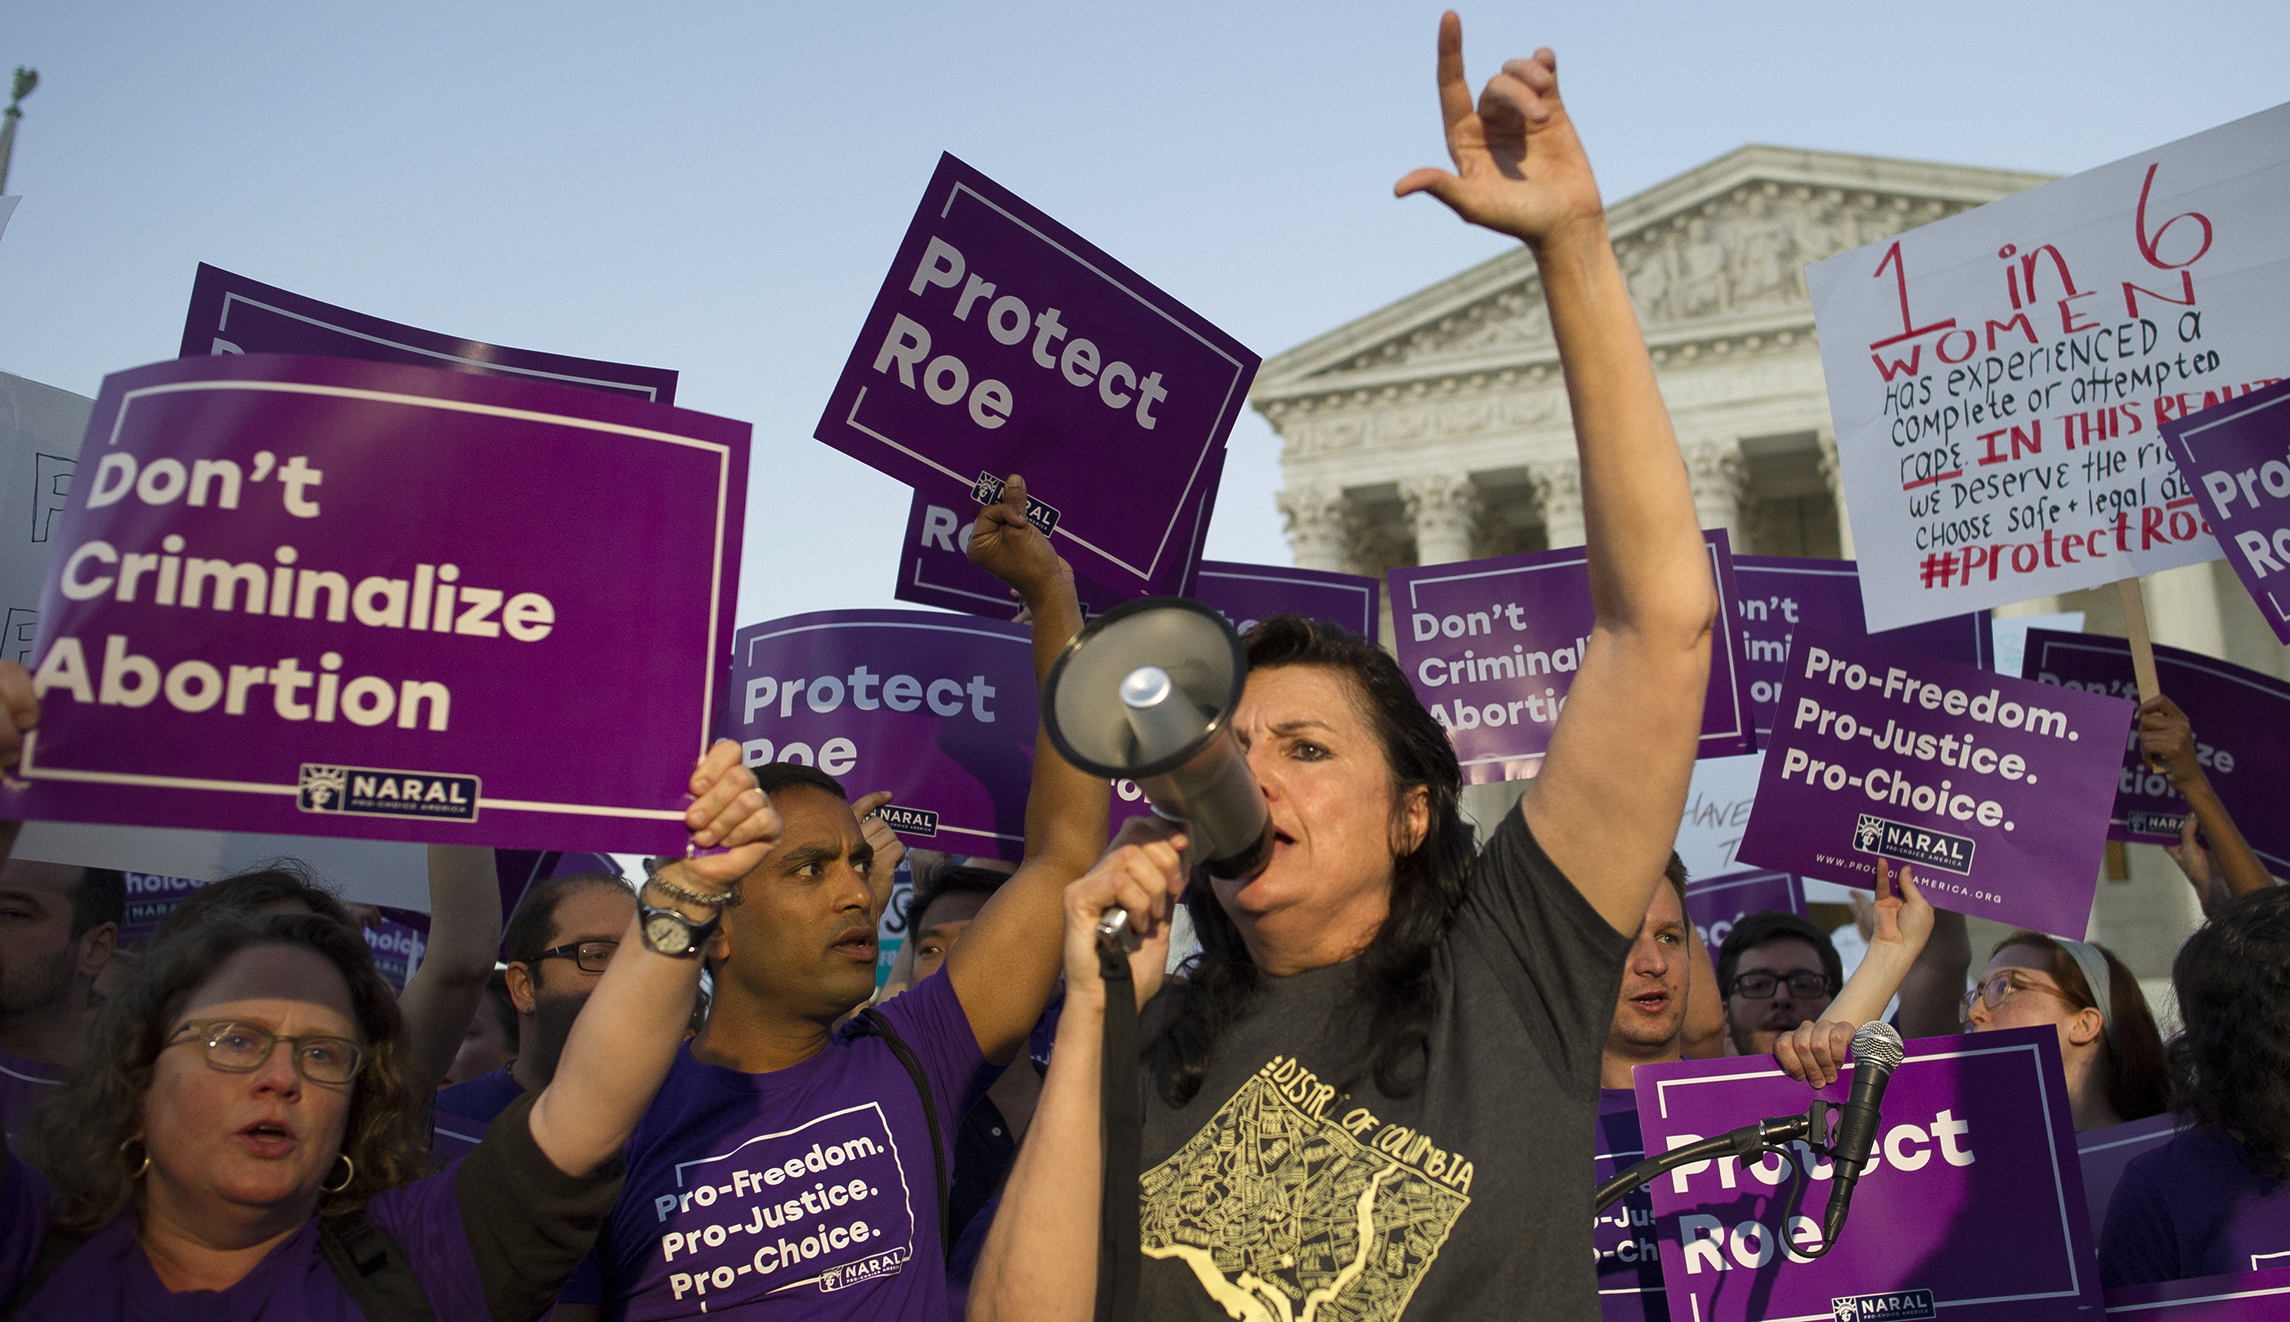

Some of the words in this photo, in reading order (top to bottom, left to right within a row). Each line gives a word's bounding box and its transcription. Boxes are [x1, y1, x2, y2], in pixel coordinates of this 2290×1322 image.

[1998, 243, 2077, 310] in
[2136, 163, 2214, 270] 6
[908, 235, 1168, 430] Protect
[1871, 270, 2197, 383] WOMEN
[2178, 310, 2203, 344] a
[872, 312, 1014, 430] Roe
[2027, 381, 2063, 412] or
[1977, 419, 2043, 467] IN
[2053, 402, 2143, 452] THIS
[86, 450, 323, 519] Don't
[2007, 496, 2061, 533] safe
[2088, 478, 2147, 524] legal
[2201, 443, 2290, 521] Pro
[60, 533, 556, 643] Criminalize
[1411, 601, 1528, 643] Don't
[32, 633, 452, 732] Abortion
[743, 664, 996, 726] Protect
[1804, 646, 2080, 742] Pro-Freedom.
[1793, 695, 2038, 786] Pro-Justice.
[352, 775, 469, 805] NARAL
[880, 808, 932, 827] NARAL
[1780, 747, 2016, 833] Pro-Choice.
[1885, 844, 1926, 859] PRO-CHOICE
[1927, 853, 1963, 868] AMERICA
[1886, 826, 1965, 861] NARAL
[1342, 1107, 1381, 1137] OF
[653, 1136, 885, 1223] Pro-Freedom.
[661, 1178, 879, 1263] Pro-Justice.
[1679, 1213, 1824, 1275] Roe
[669, 1219, 882, 1301] Pro-Choice.
[845, 1251, 901, 1279] NARAL
[1861, 1294, 1928, 1315] NARAL
[1863, 1311, 1900, 1320] PRO-CHOICE
[1901, 1308, 1929, 1316] AMERICA
